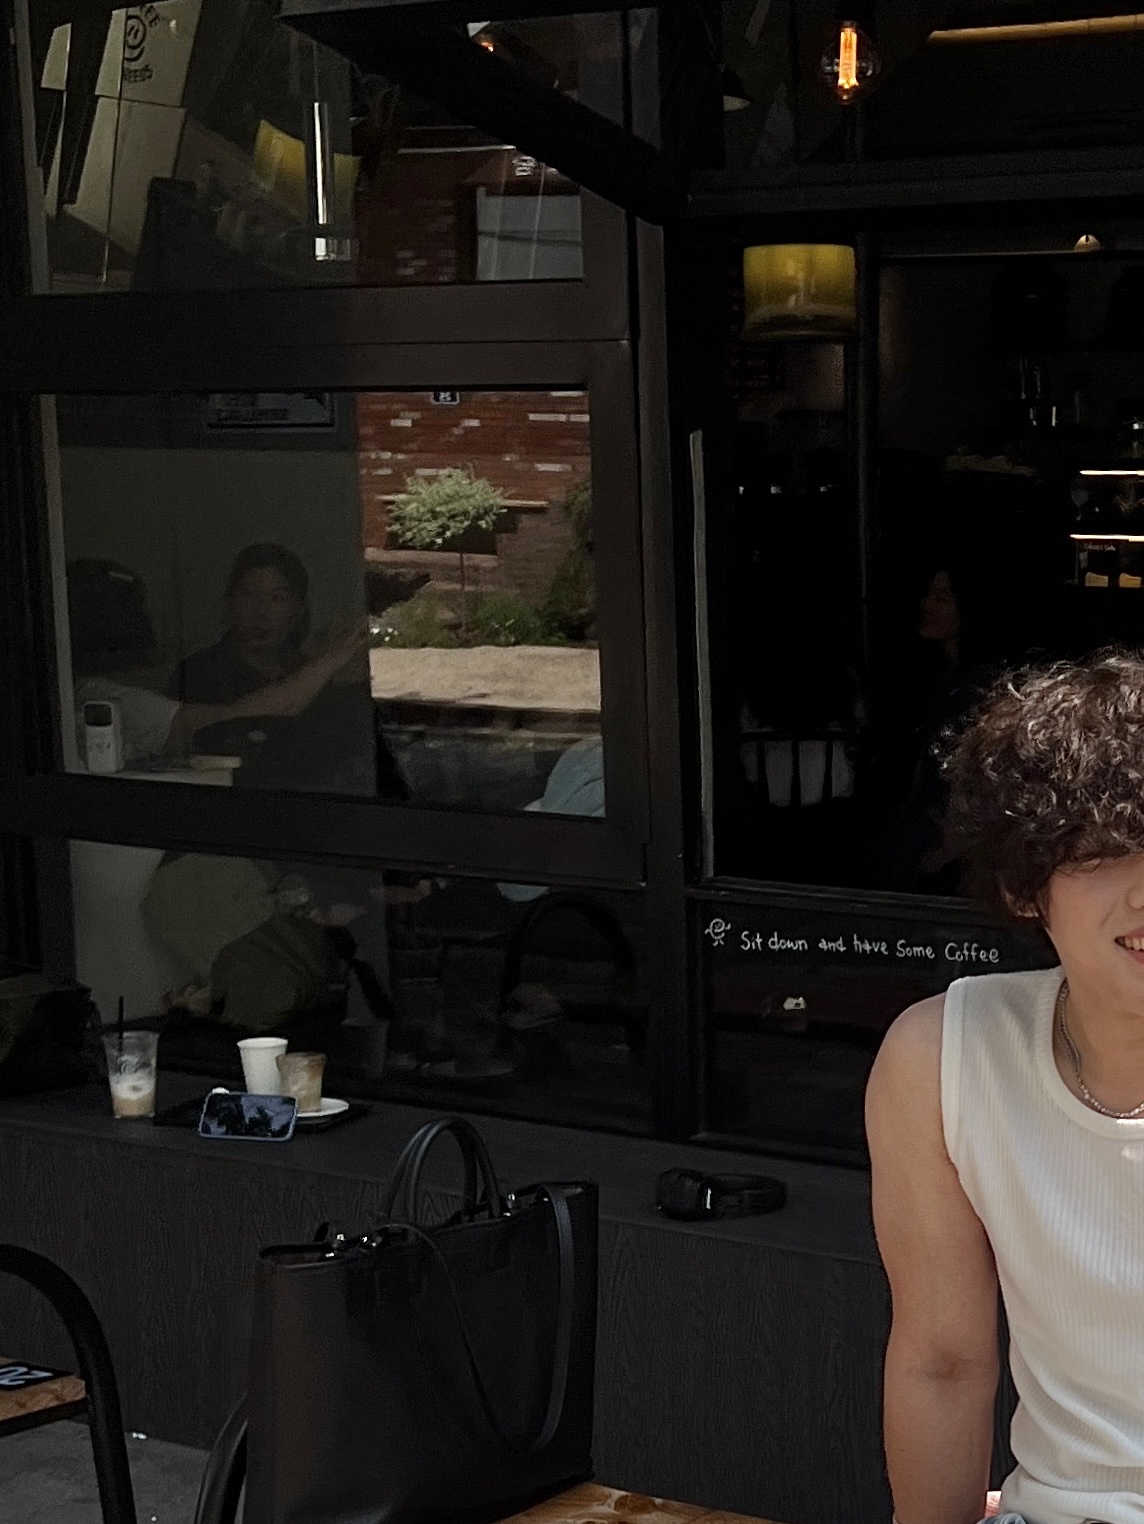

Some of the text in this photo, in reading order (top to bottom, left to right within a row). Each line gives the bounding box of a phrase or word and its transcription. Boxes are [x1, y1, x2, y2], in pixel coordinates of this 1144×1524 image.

[740, 931, 1000, 963] Sit down and have Some Coffee
